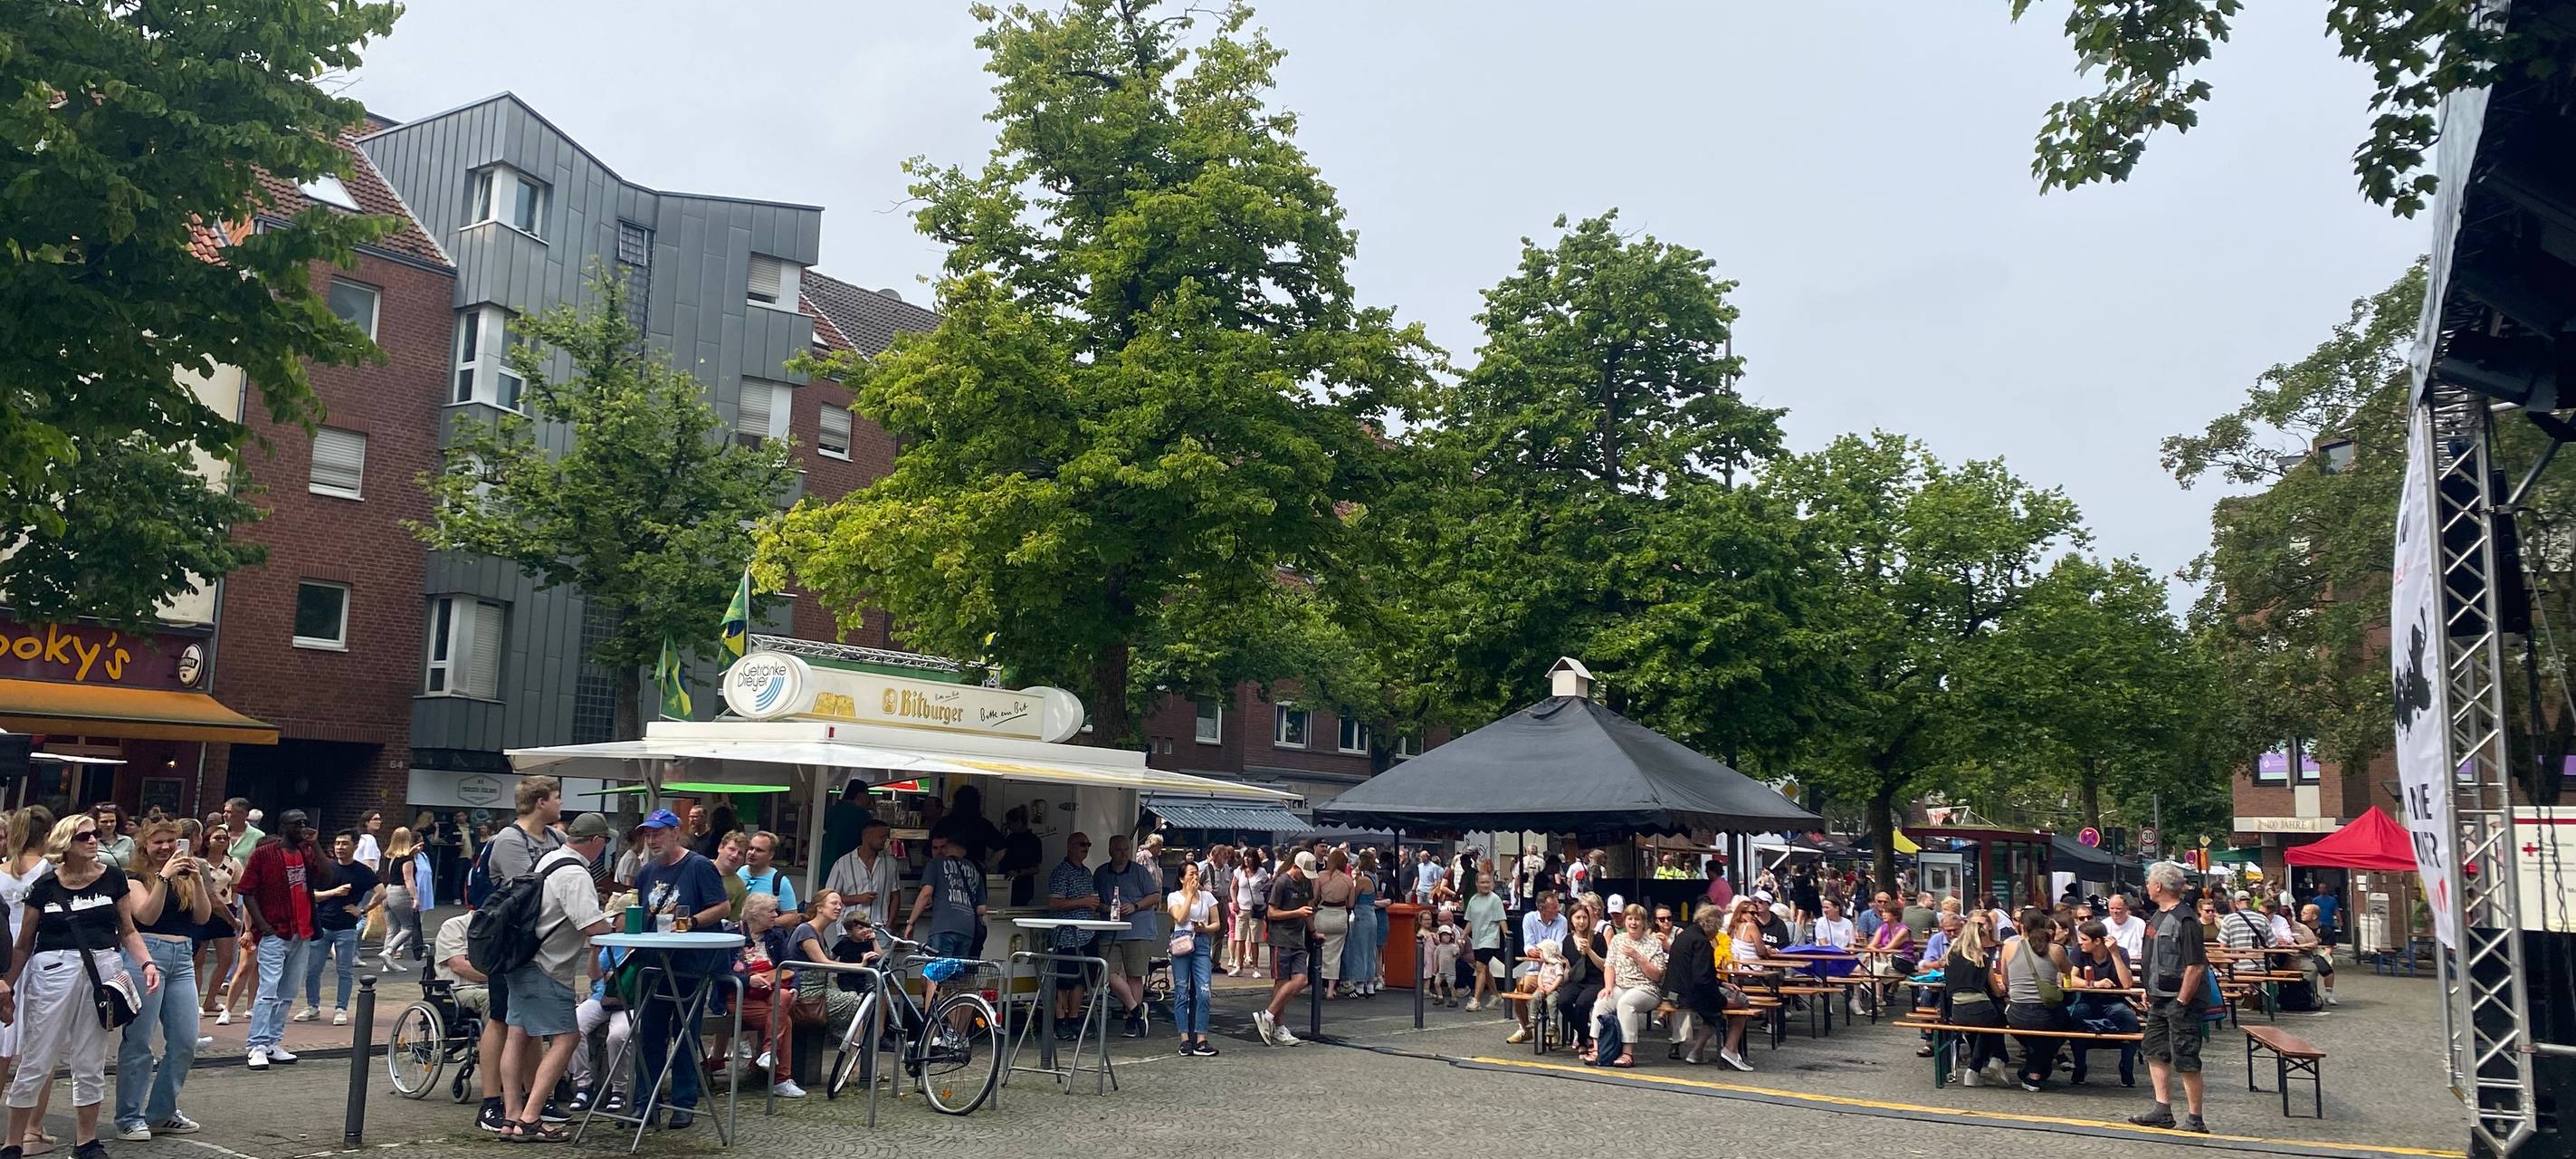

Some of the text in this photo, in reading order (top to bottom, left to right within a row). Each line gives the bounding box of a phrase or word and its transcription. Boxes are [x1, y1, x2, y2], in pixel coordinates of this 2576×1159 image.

[738, 672, 768, 692] Dreyer
[899, 690, 964, 725] Bitburger
[2280, 819, 2307, 830] JAHRE
[2143, 832, 2154, 840] 30
